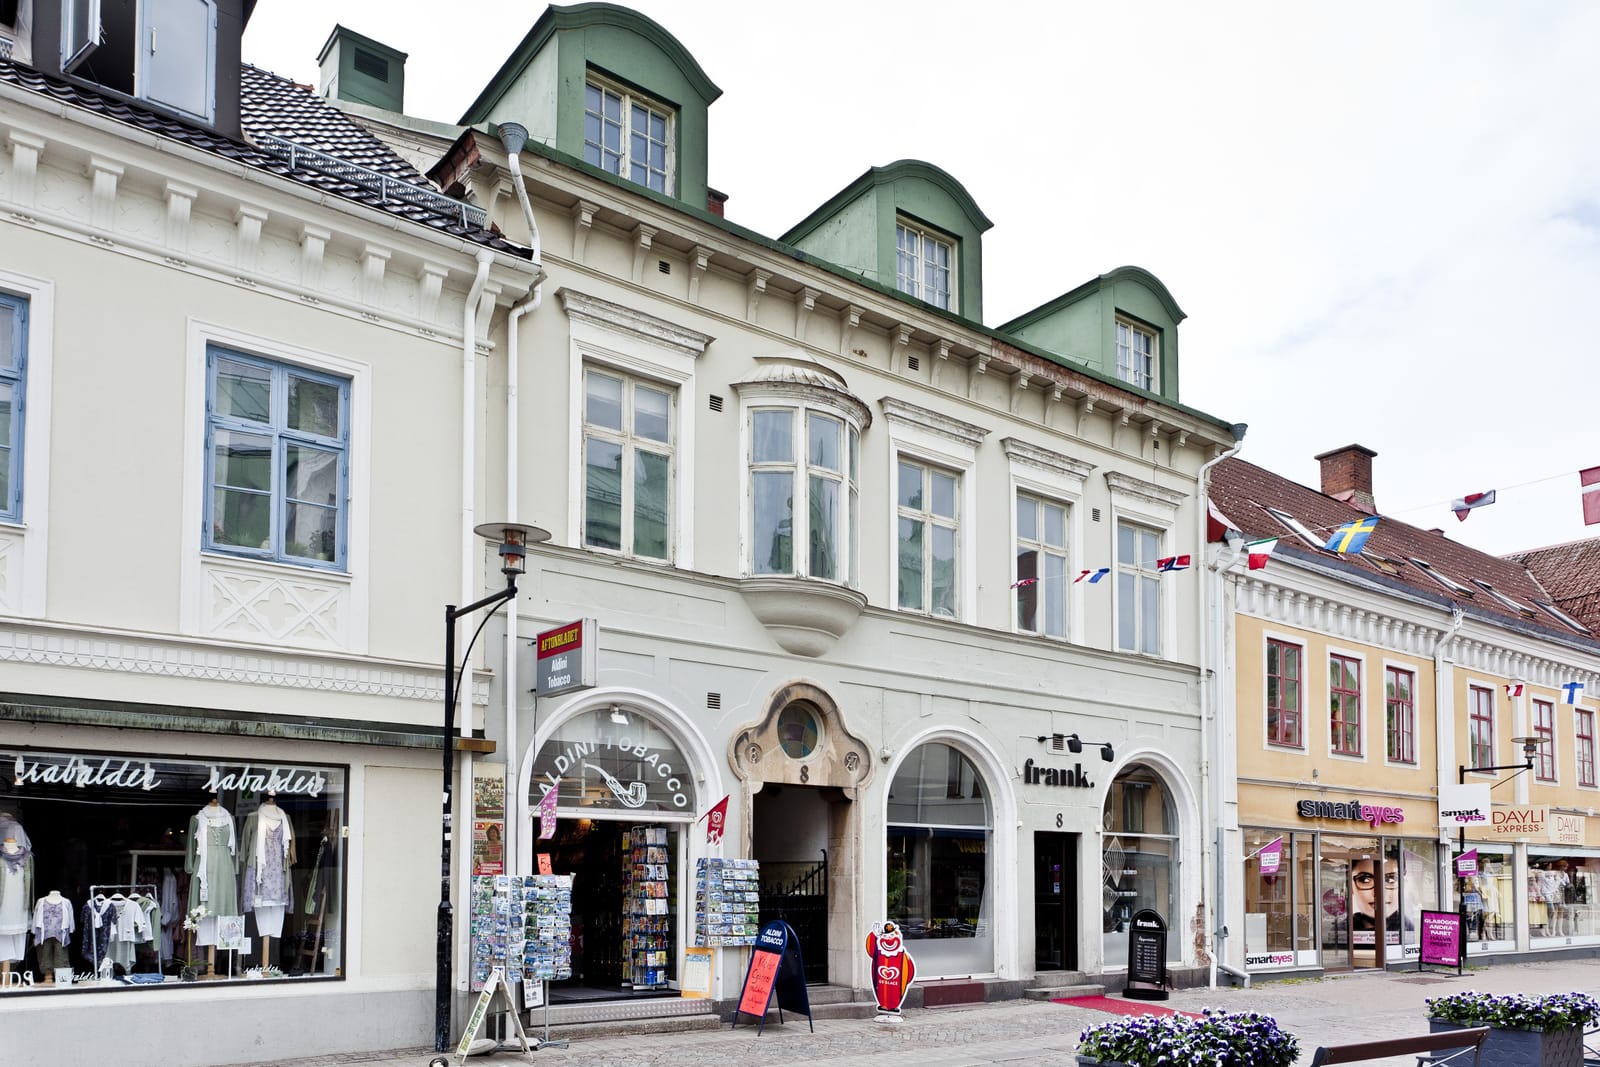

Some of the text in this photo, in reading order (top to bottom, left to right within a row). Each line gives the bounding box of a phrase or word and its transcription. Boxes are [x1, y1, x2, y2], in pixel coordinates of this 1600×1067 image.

[541, 628, 579, 652] AFTONBLADET
[551, 656, 568, 672] Aldini
[548, 674, 571, 688] Tobacco
[539, 737, 596, 797] ALDINI
[606, 735, 687, 808] TOBACCO
[800, 765, 809, 783] 8
[1024, 758, 1095, 788] frank.
[1056, 813, 1063, 828] 8
[1298, 800, 1404, 827] smarteyes
[1441, 808, 1480, 817] smart
[1455, 815, 1486, 823] eyes
[1492, 809, 1544, 825] DAYLI
[1557, 816, 1581, 832] DAYLI
[761, 935, 784, 946] TOBACCO
[766, 928, 782, 937] ALDINI
[1246, 953, 1292, 965] smarteyes
